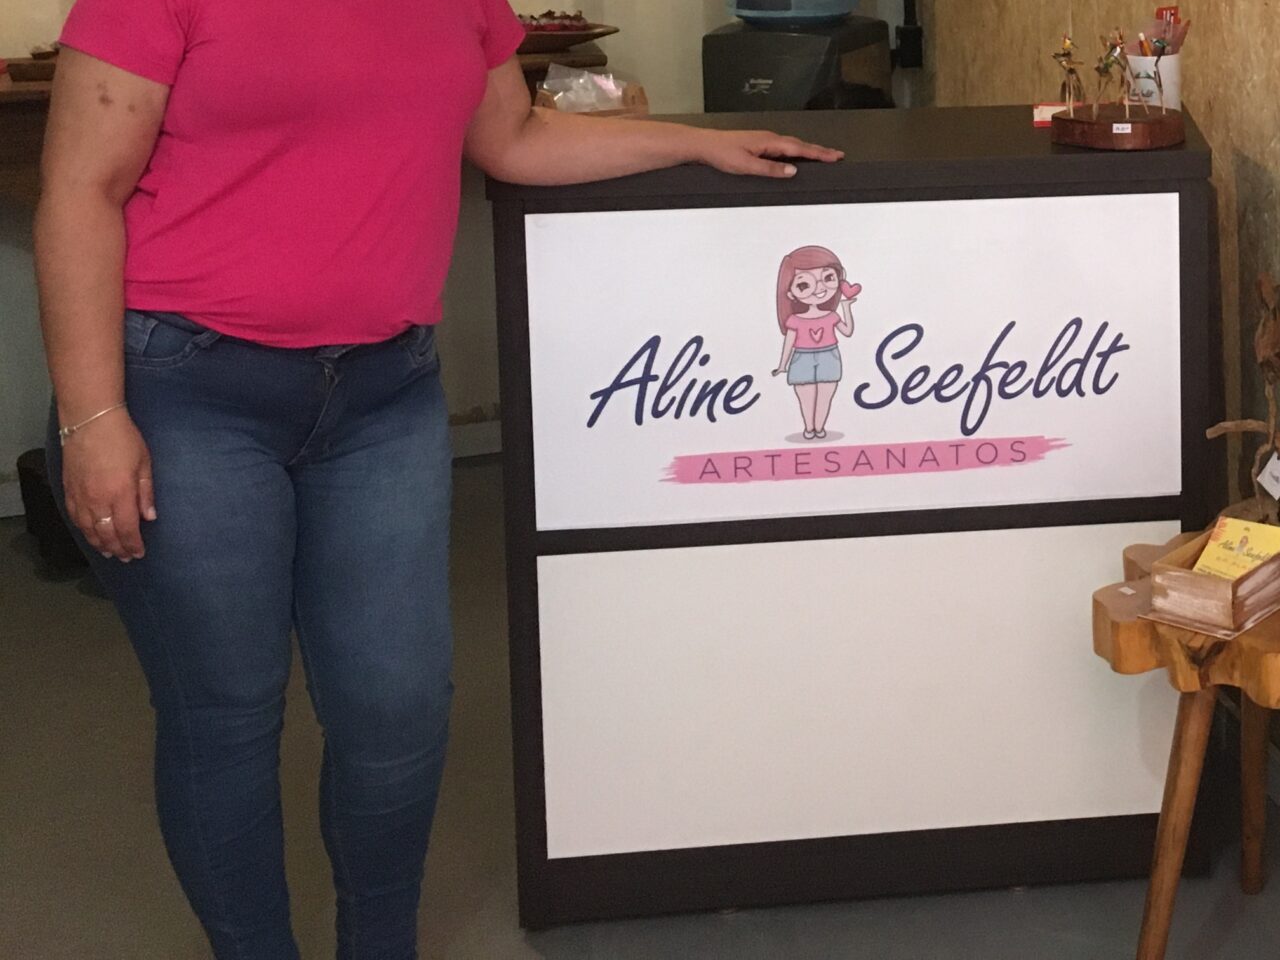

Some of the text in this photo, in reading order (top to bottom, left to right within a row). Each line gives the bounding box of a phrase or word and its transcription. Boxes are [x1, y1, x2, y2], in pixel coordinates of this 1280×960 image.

[587, 317, 1130, 436] Aline Seefeldt
[699, 440, 1028, 480] ARTESANATOS
